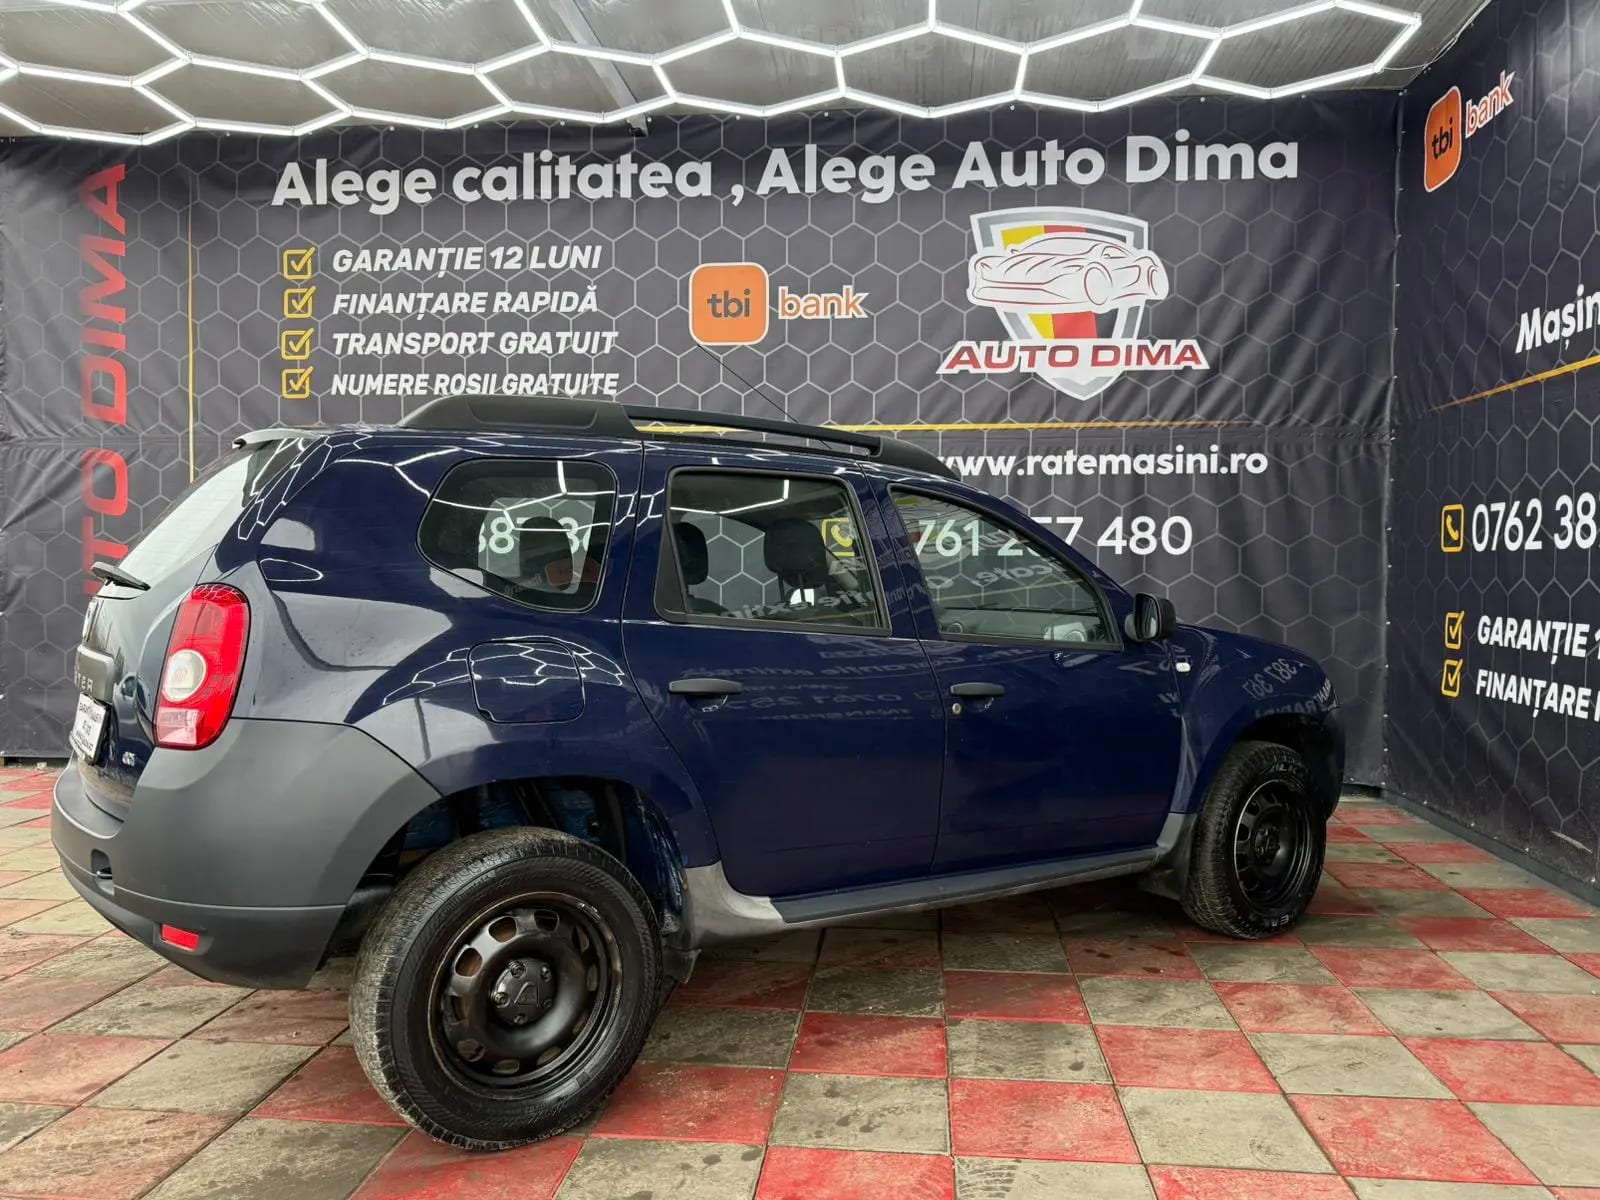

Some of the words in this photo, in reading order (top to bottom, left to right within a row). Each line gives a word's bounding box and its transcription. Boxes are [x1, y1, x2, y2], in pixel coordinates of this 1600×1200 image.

[1432, 117, 1453, 160] tbi
[1466, 71, 1515, 139] bank
[271, 158, 437, 215] Alege
[452, 150, 712, 201] calitatea
[757, 144, 935, 203] Alege
[952, 139, 1105, 189] Auto
[1126, 130, 1298, 183] Dima
[333, 247, 484, 278] GARANȚIE
[490, 246, 524, 270] 12
[530, 246, 602, 269] LUNI
[81, 163, 127, 425] DIMA
[333, 292, 489, 320] FINANȚARE
[493, 286, 598, 313] RAPIDĂ
[706, 289, 751, 318] tbi
[778, 286, 870, 320] bank
[333, 332, 495, 355] TRANSPORT
[500, 331, 619, 354] GRATUIT
[945, 345, 1080, 369] AUTO
[1091, 343, 1204, 368] DIMA
[331, 374, 429, 396] NUMERE
[434, 374, 498, 396] ROSII
[502, 373, 620, 396] GRATUITE
[82, 448, 128, 597] TO
[1097, 515, 1193, 555] 480
[1472, 498, 1543, 552] 0762
[1553, 492, 1600, 549] 38
[1477, 615, 1590, 665] GARANȚIE
[1476, 669, 1592, 719] FINANȚARE
